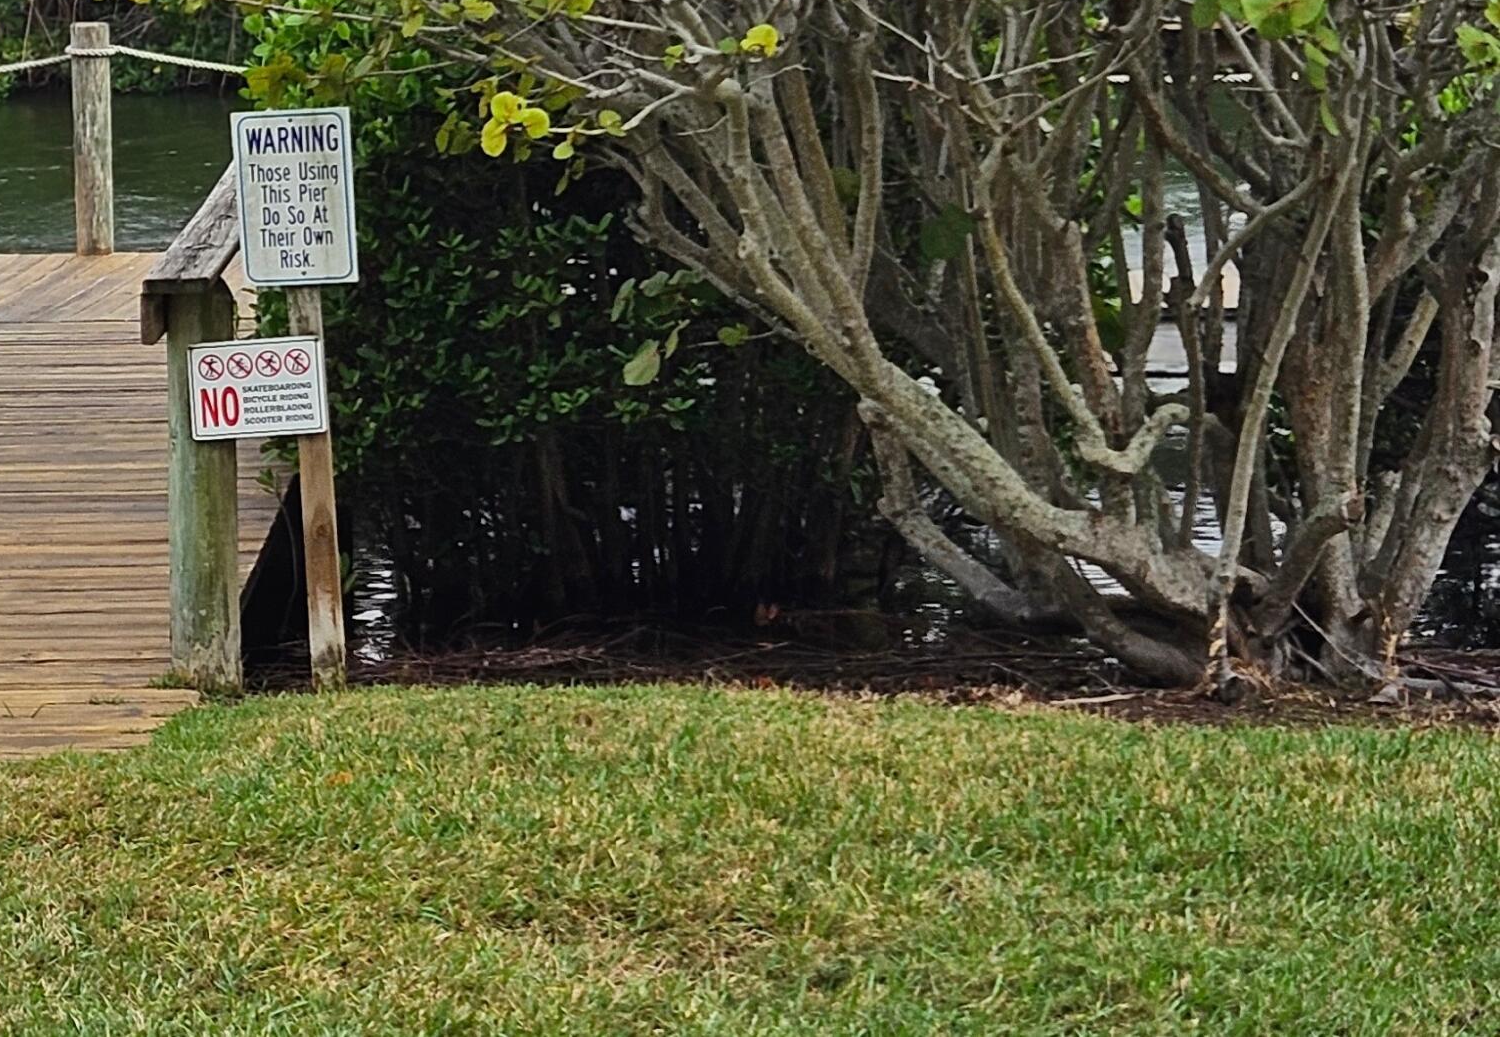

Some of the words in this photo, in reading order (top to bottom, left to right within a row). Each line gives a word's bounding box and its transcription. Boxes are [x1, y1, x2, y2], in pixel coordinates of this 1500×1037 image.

[246, 124, 339, 155] WARNING
[249, 163, 291, 182] Those
[298, 162, 338, 185] Using
[261, 185, 291, 204] This
[299, 184, 327, 202] Pier
[263, 207, 280, 225] Do
[288, 206, 304, 224] So
[313, 205, 328, 224] At
[260, 228, 296, 247] Their
[303, 227, 333, 246] Own
[280, 249, 315, 268] Risk.
[242, 382, 312, 393] SKATEBOARDING
[200, 386, 239, 428] NO
[243, 394, 277, 403] BICYCLE
[244, 403, 312, 414] ROLLERBLADING
[244, 416, 282, 424] SCOOTER
[285, 414, 314, 422] RIDING
